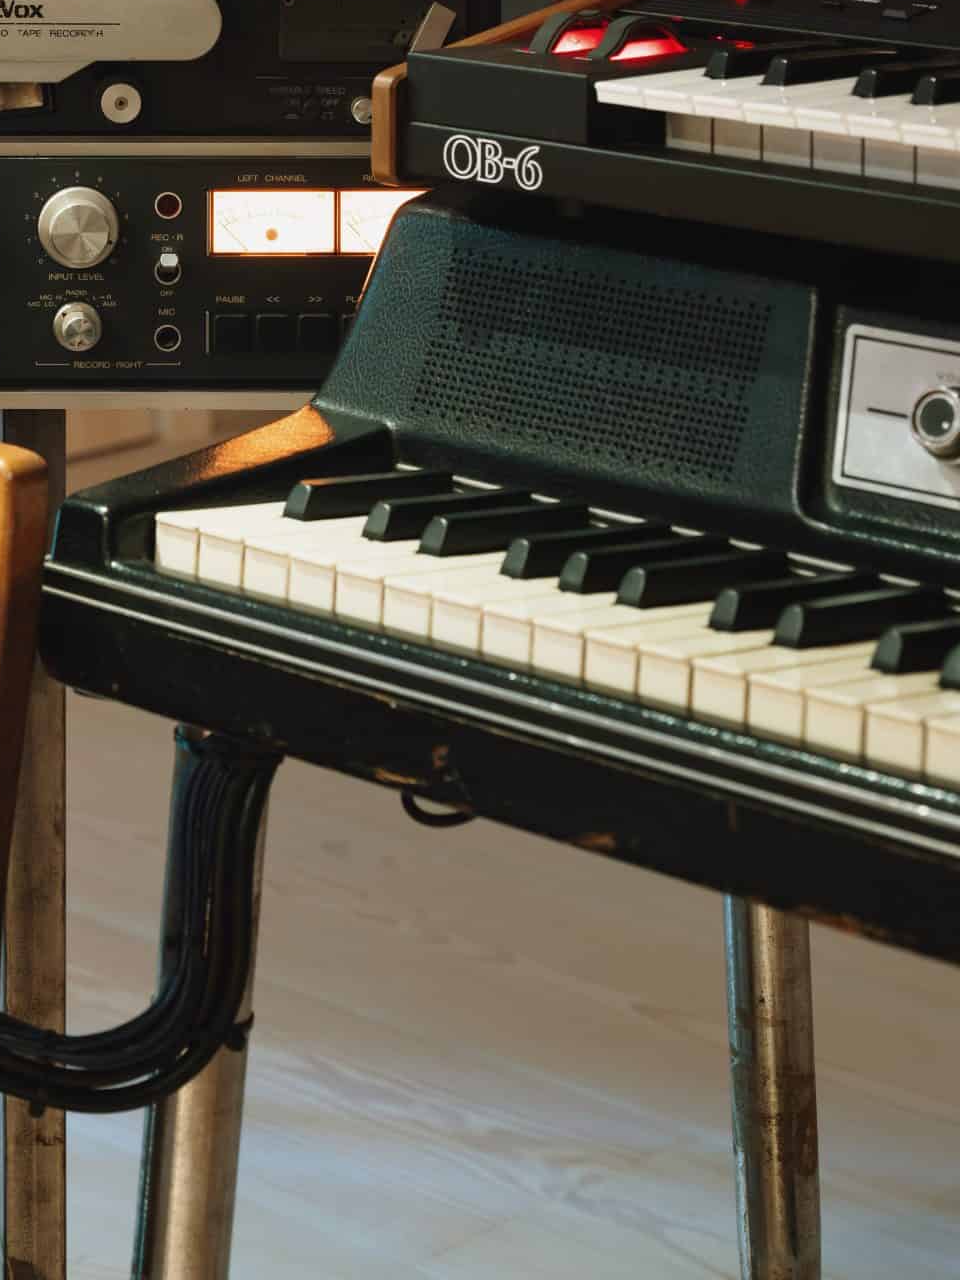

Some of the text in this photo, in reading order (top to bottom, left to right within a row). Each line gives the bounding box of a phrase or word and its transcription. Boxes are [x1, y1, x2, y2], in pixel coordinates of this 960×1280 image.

[443, 134, 543, 190] OB-6
[237, 175, 259, 183] LEFT
[48, 273, 104, 281] INPUT LEVEL
[216, 295, 246, 303] PAUSE
[158, 308, 176, 316] MIC
